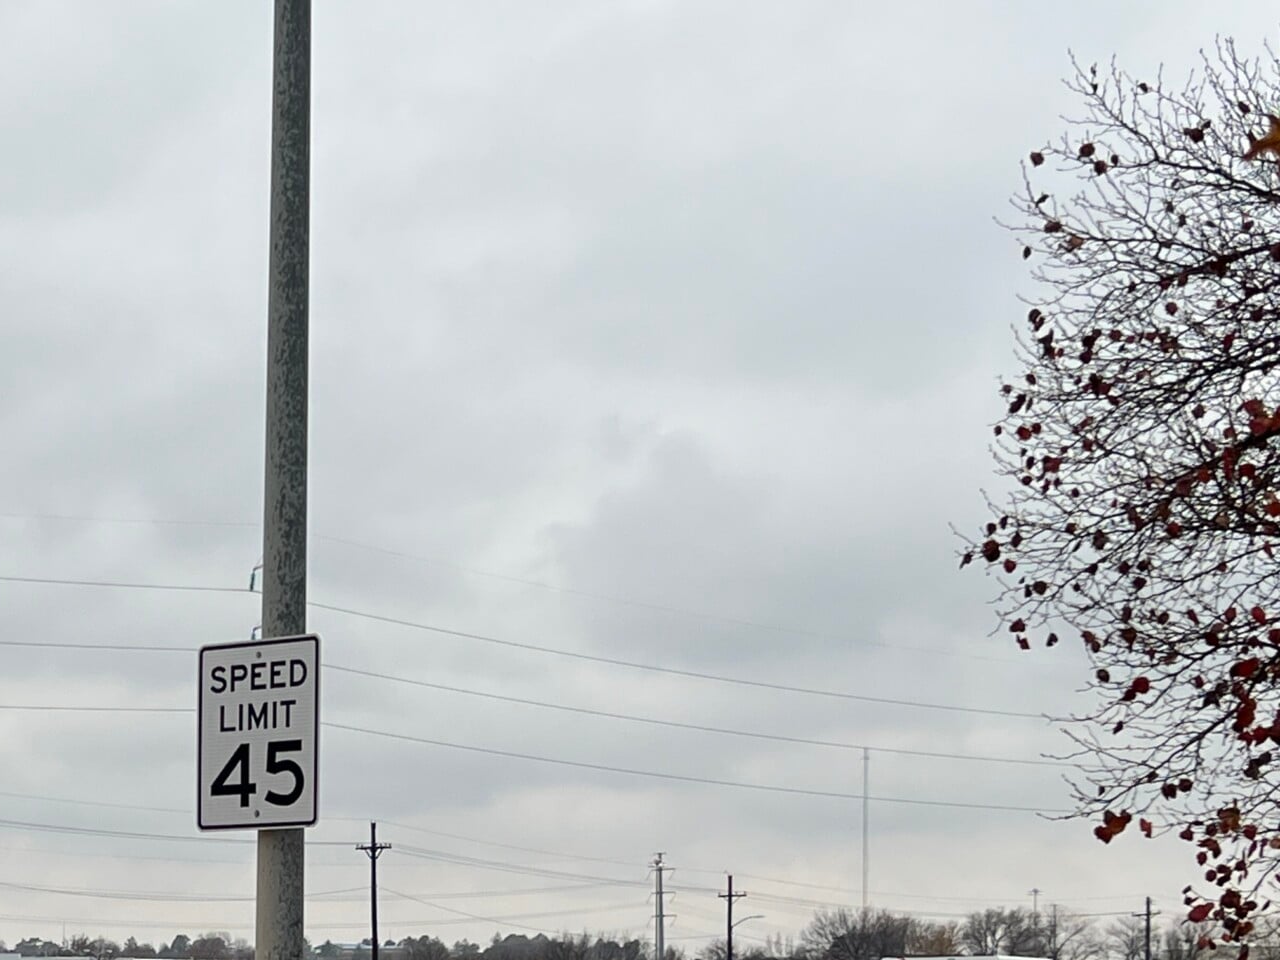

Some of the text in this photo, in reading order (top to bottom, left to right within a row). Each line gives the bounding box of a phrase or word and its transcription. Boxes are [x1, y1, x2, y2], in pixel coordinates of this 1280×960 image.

[210, 659, 308, 694] SPEED
[220, 700, 297, 732] LIMIT
[210, 739, 305, 808] 45
